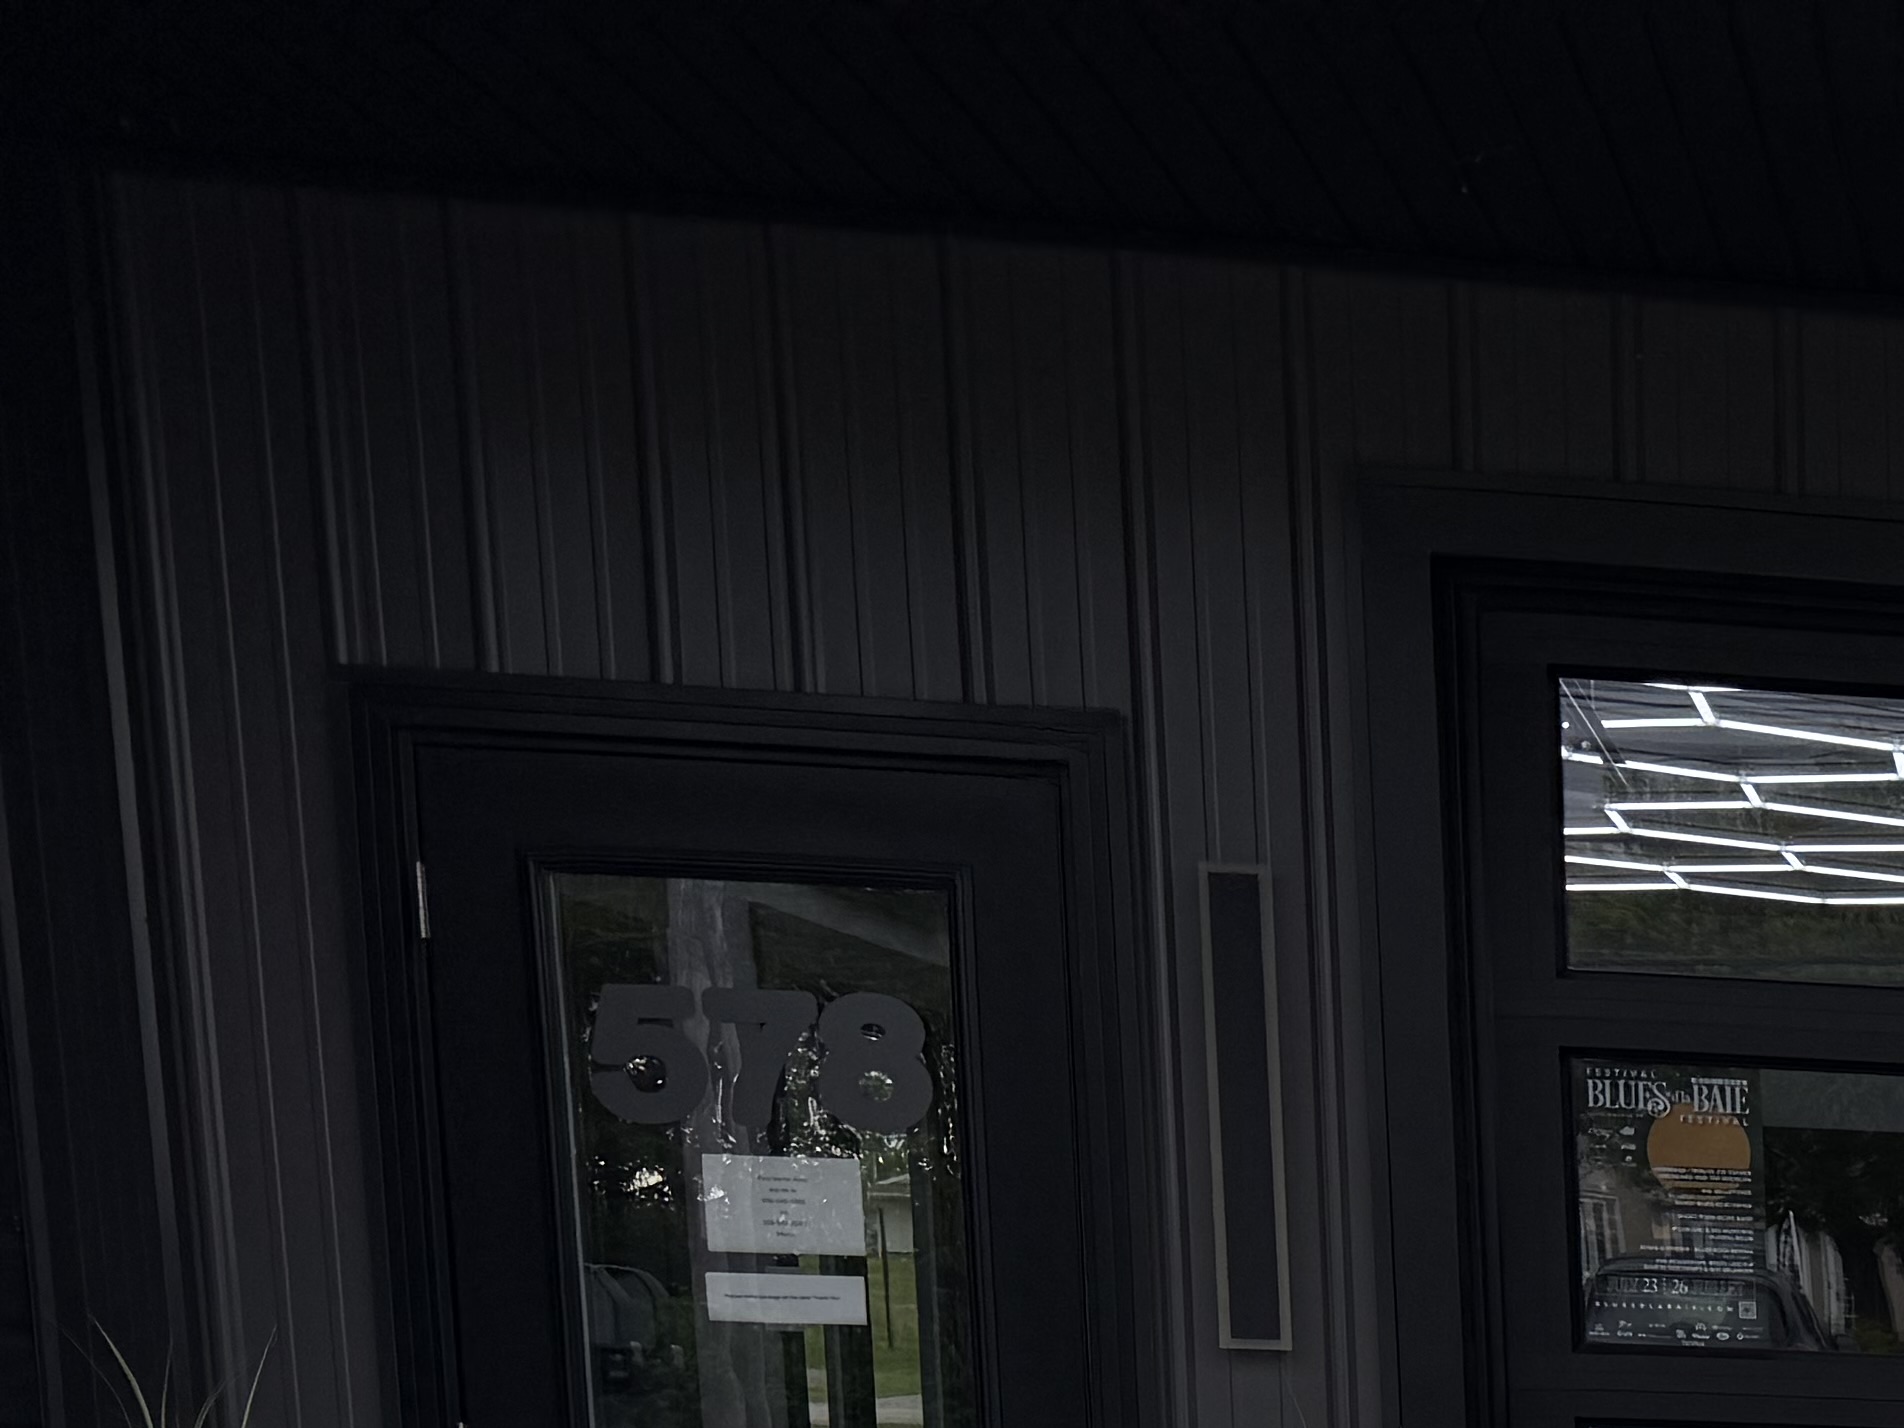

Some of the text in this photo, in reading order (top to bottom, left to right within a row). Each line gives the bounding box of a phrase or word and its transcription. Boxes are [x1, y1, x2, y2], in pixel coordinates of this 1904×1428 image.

[591, 983, 934, 1131] 578
[1587, 1078, 1672, 1117] BLUES
[1693, 1084, 1750, 1114] BAIE
[1642, 1278, 1658, 1293] 23
[1671, 1279, 1688, 1294] 26
